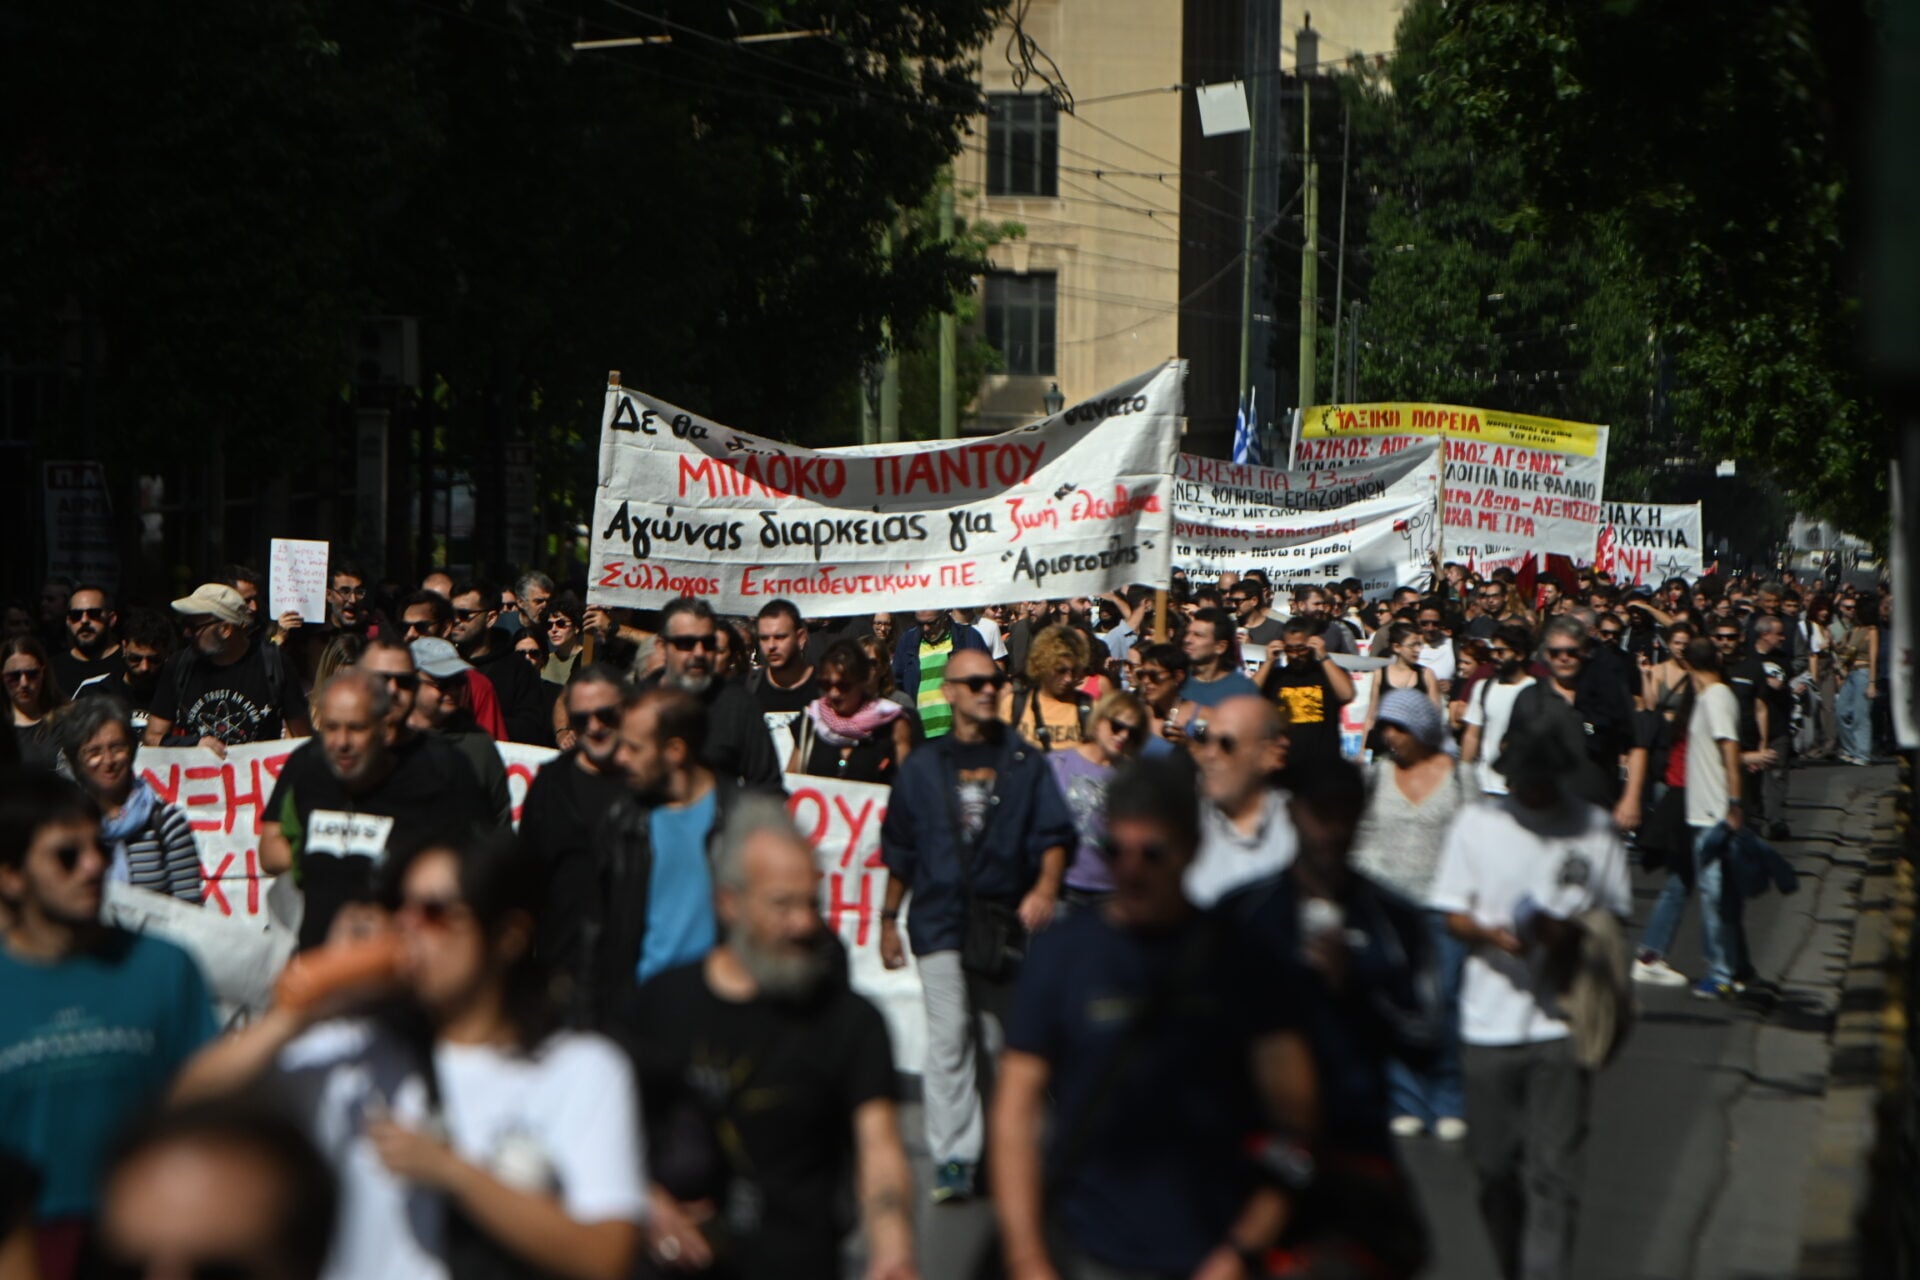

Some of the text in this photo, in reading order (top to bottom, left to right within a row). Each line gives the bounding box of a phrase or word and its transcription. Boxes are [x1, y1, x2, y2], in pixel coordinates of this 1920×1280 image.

[611, 397, 659, 434] Δε
[672, 414, 709, 441] θα
[1412, 410, 1480, 433] ΠΟΡΕΙΑ
[678, 441, 1046, 499] ΜΠΛΟΚΟ ΠΑΝΤΟΥ
[1493, 447, 1567, 476] ΑΓΩΝΑΣ
[603, 500, 747, 559] Αγώνας
[759, 505, 928, 561] διαρκείας
[948, 509, 996, 552] για
[1176, 545, 1190, 557] τα
[1194, 543, 1236, 560] κέρδη
[1293, 546, 1305, 558] οι
[1309, 540, 1352, 560] μισθοί
[740, 562, 931, 597] Εκπαιδευτικών
[204, 689, 231, 704] TRUST
